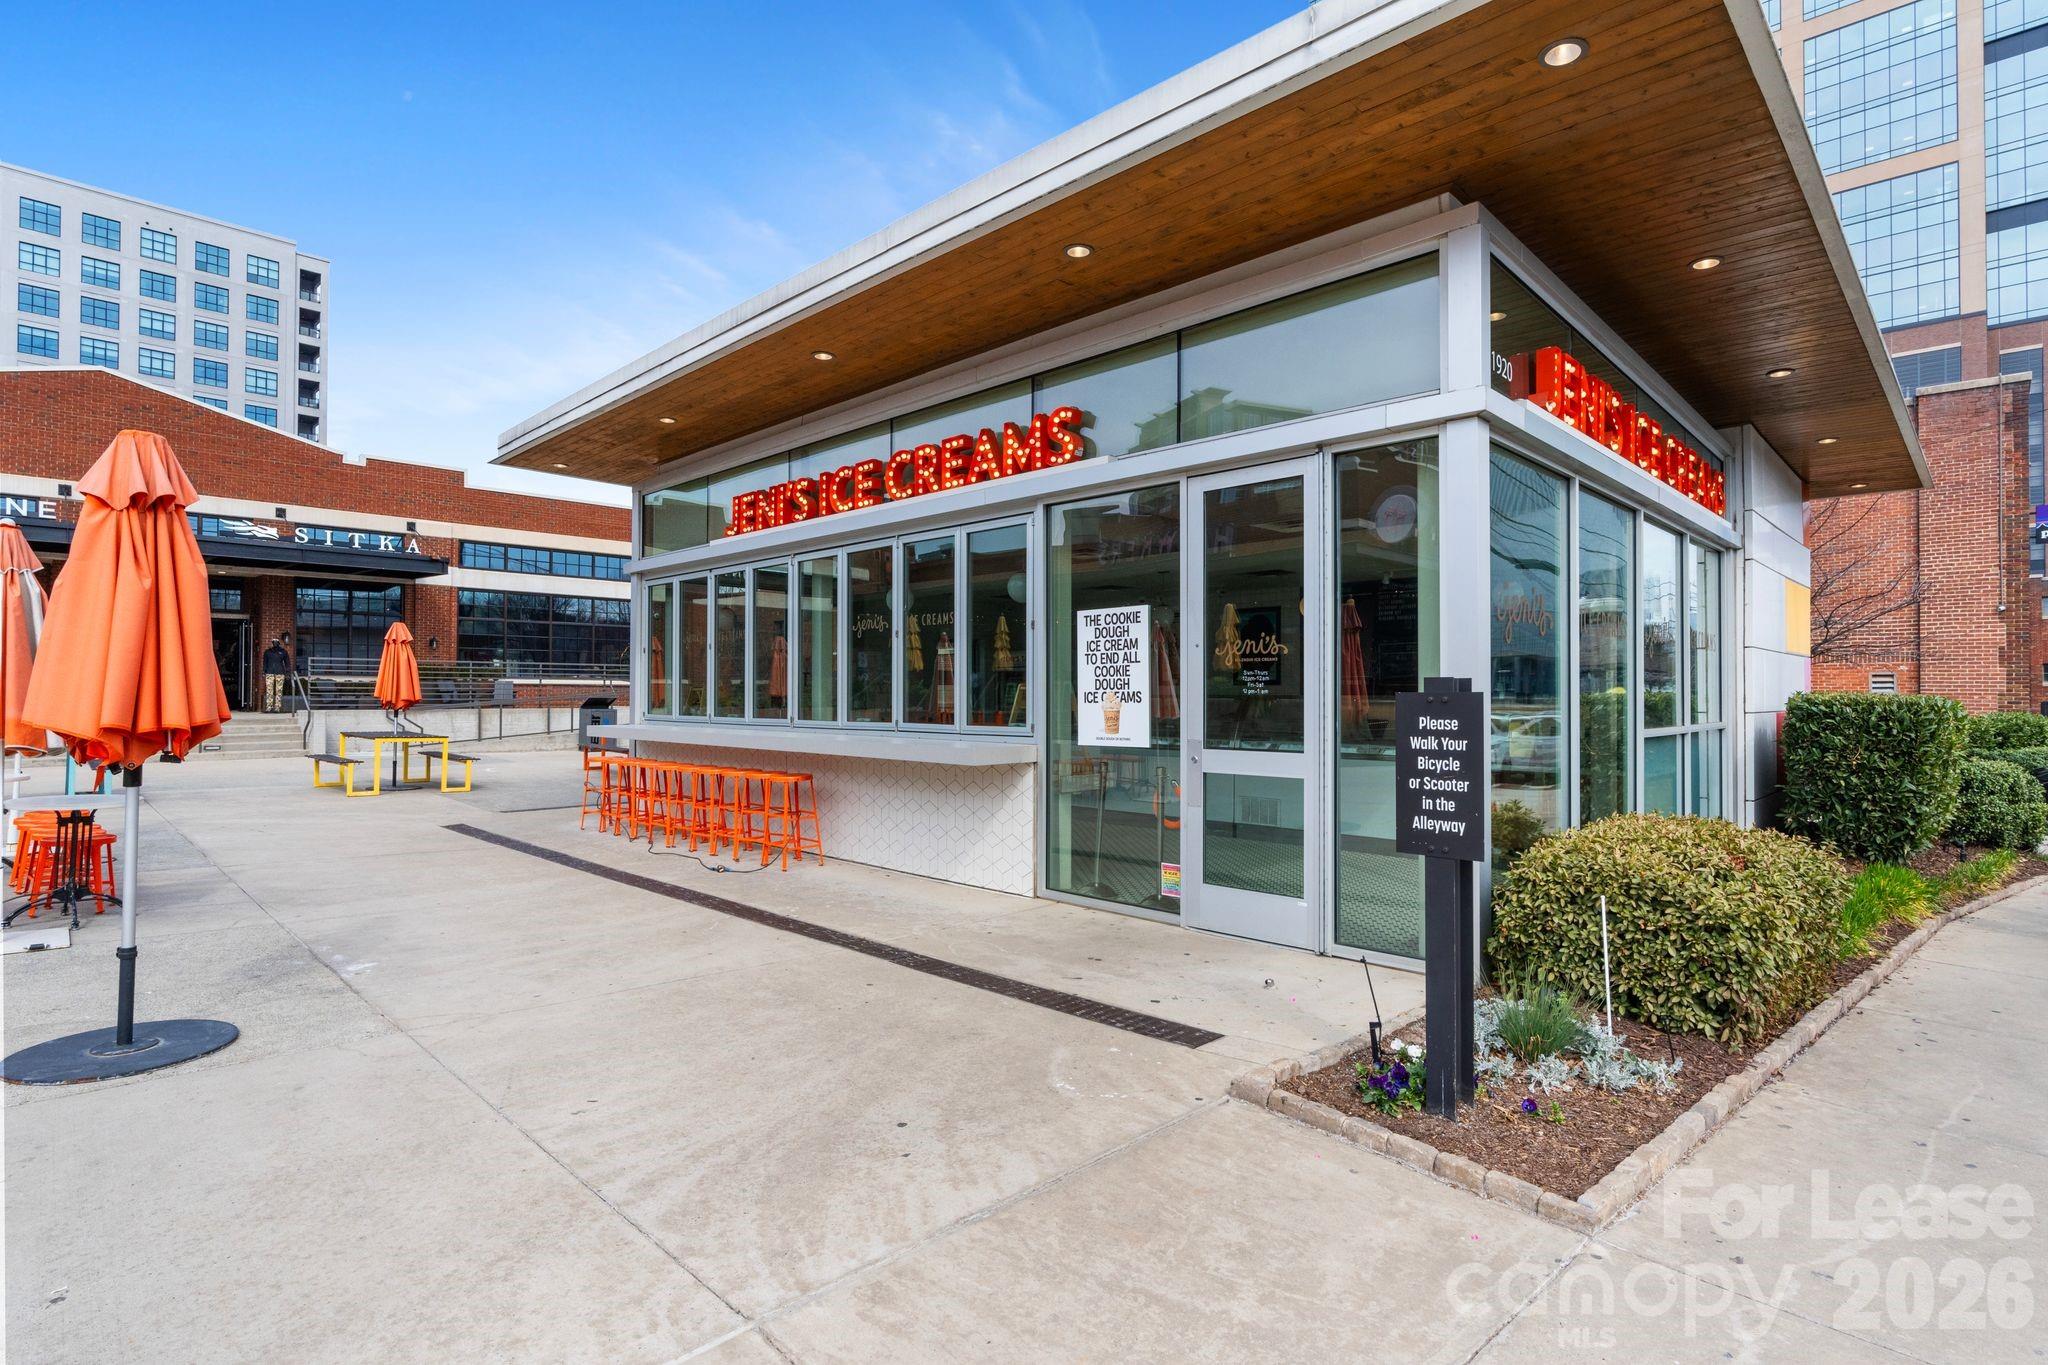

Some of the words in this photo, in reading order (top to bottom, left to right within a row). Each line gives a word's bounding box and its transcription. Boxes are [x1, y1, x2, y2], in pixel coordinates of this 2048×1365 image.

[1491, 351, 1513, 382] 1920
[724, 477, 817, 537] JENI'S
[819, 459, 883, 518] ICE
[884, 406, 1085, 501] CREAMS
[294, 526, 422, 555] SITKA
[921, 611, 954, 626] CREAMS
[1084, 614, 1101, 627] THE
[1104, 611, 1141, 625] COOKIE
[1094, 626, 1130, 639] DOUGH
[1086, 640, 1101, 652] ICE
[1104, 638, 1138, 652] CREAM
[1085, 653, 1097, 665] TO
[1100, 652, 1119, 665] END
[1122, 651, 1140, 664] ALL
[1094, 665, 1131, 678] COOKIE
[1094, 678, 1130, 691] DOUGH
[1084, 692, 1098, 704] ICE
[1418, 716, 1459, 731] Please
[1409, 736, 1438, 750] Walk
[1441, 737, 1468, 751] Your
[1417, 756, 1460, 773] Bicycle
[1409, 778, 1420, 789] or
[1423, 777, 1469, 792] Scooter
[1422, 796, 1433, 810] in
[1436, 797, 1456, 812] the
[1412, 816, 1466, 836] Alleyway
